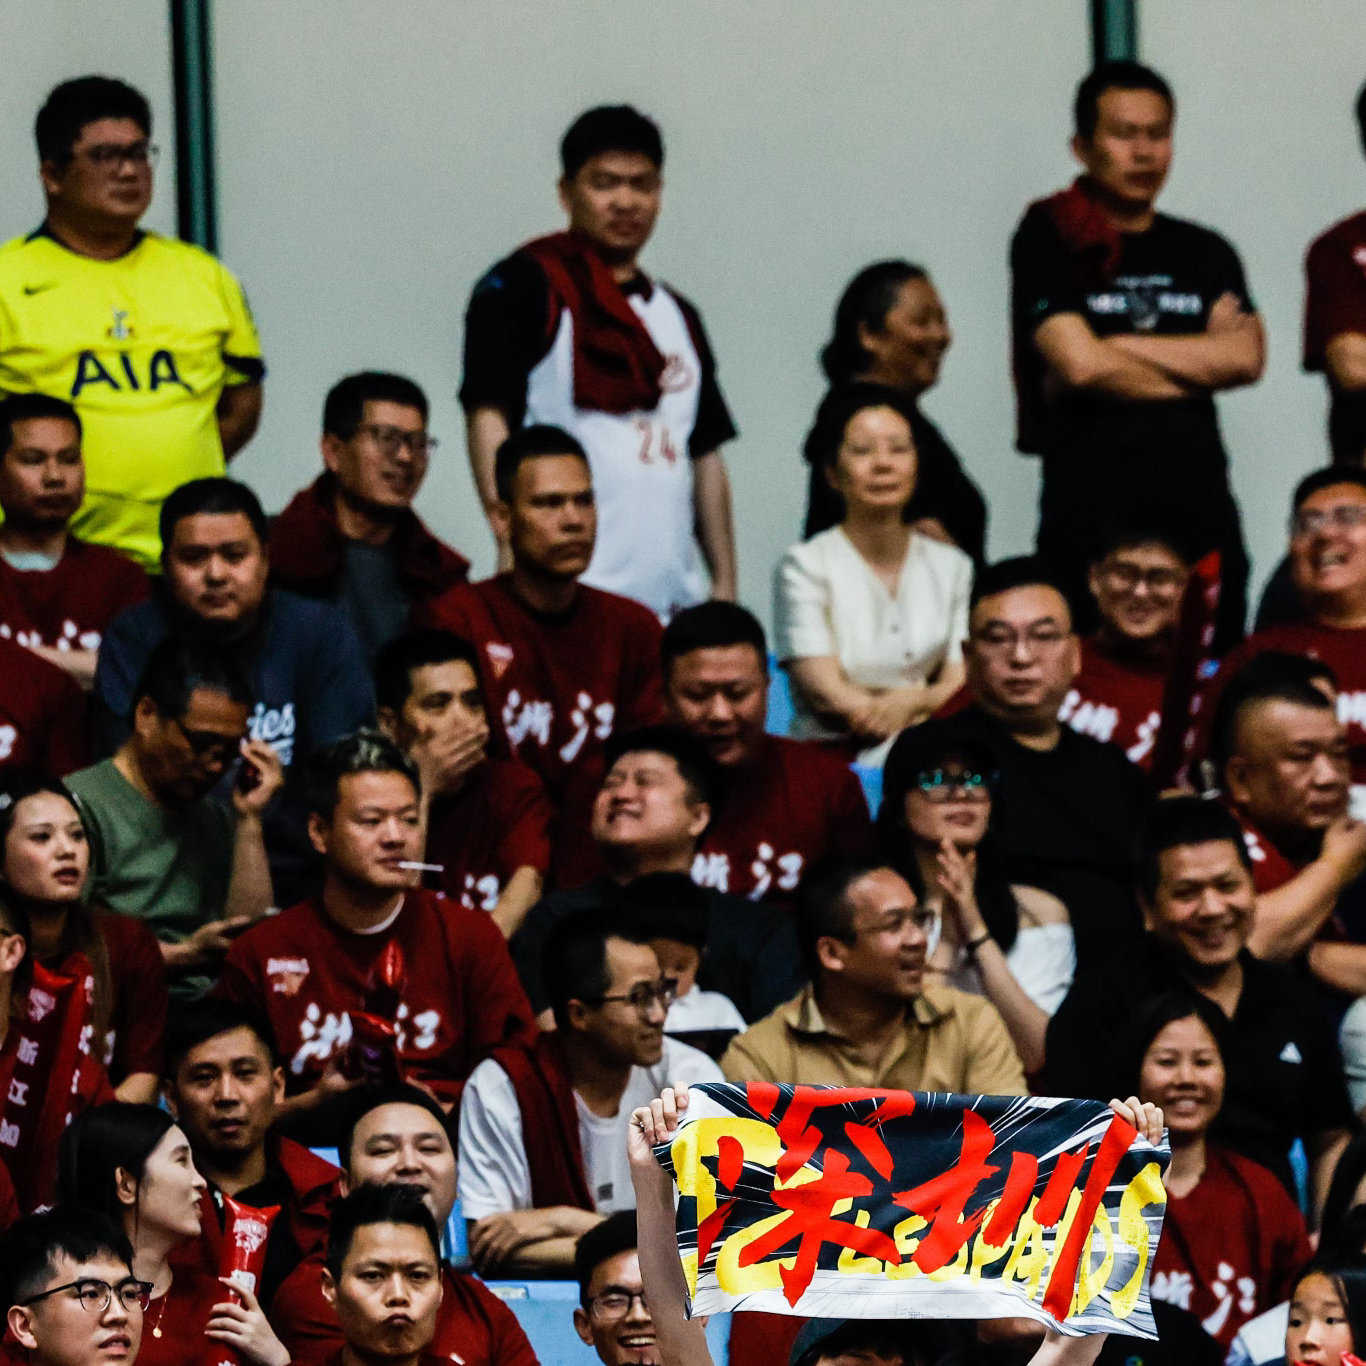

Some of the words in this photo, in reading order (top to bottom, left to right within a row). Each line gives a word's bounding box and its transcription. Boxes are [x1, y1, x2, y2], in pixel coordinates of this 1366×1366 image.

[70, 347, 194, 397] AIA
[697, 1081, 1138, 1324] 深圳
[837, 1163, 1168, 1321] LEPADS
